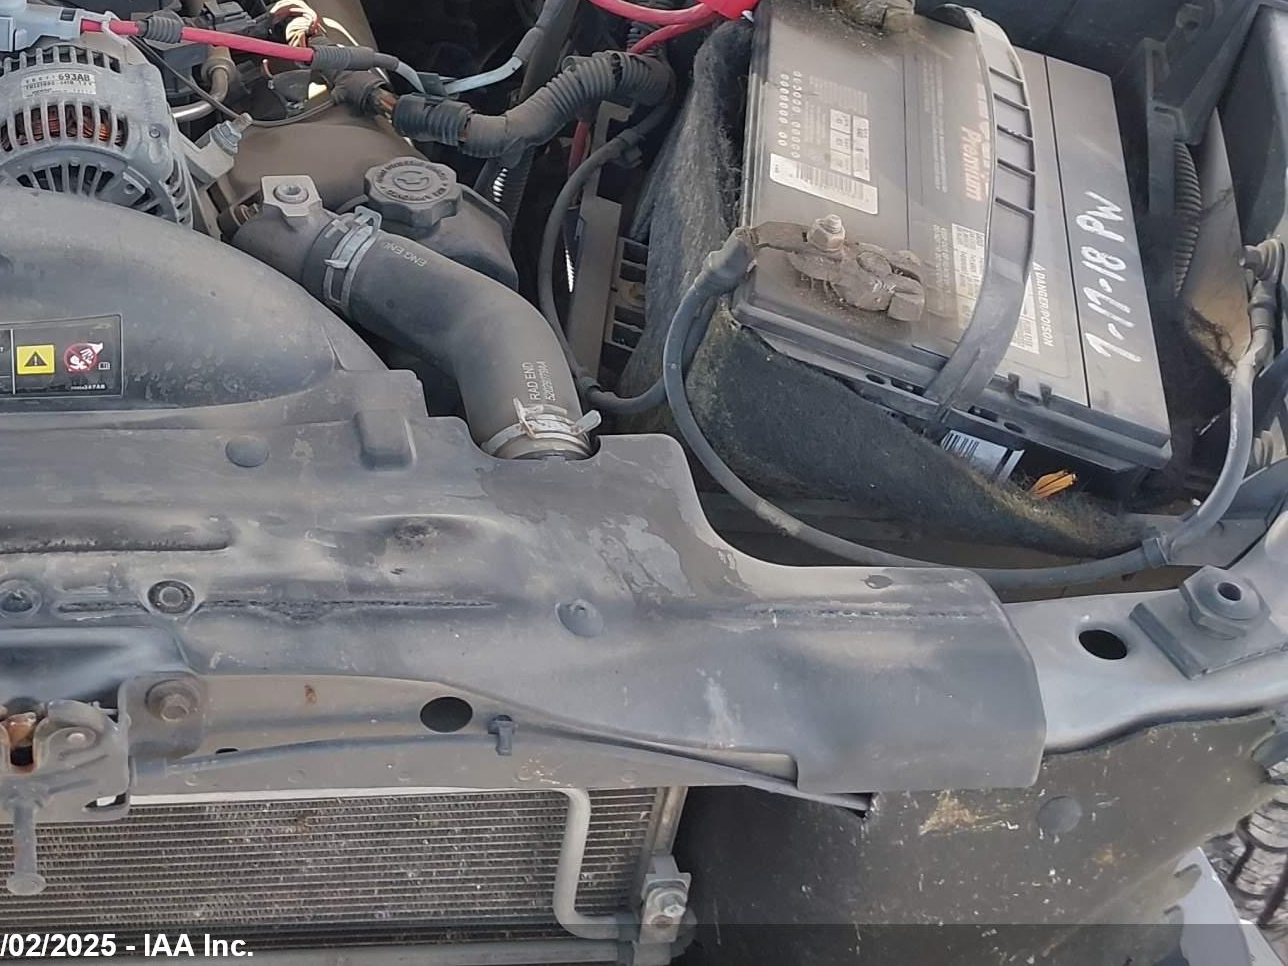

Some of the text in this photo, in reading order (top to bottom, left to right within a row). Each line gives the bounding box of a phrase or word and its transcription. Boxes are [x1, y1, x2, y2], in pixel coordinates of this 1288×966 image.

[960, 126, 985, 201] Premium
[524, 361, 541, 401] RAD END
